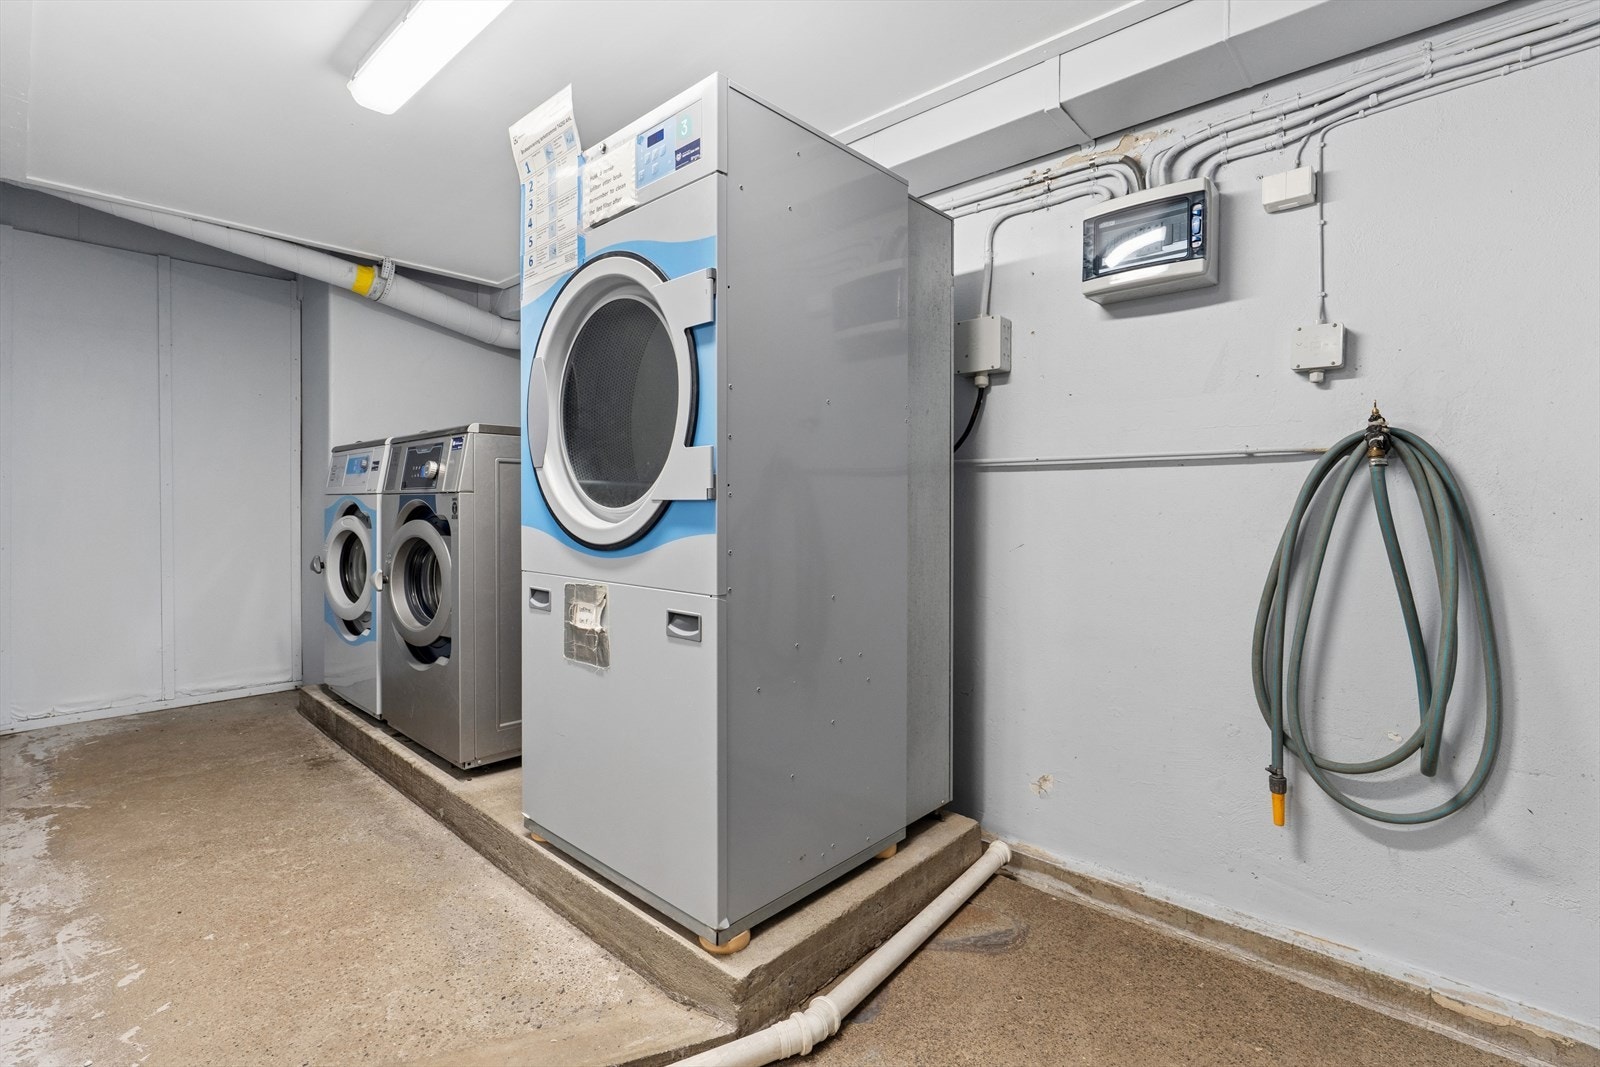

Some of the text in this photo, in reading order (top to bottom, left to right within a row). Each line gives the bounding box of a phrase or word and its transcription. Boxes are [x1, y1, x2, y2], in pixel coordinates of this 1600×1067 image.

[680, 119, 688, 136] 3
[525, 161, 531, 174] 1
[529, 180, 534, 192] 2
[615, 182, 626, 192] clean
[528, 199, 534, 211] 3
[528, 217, 533, 228] 4
[528, 235, 533, 248] 5
[528, 255, 534, 267] 6
